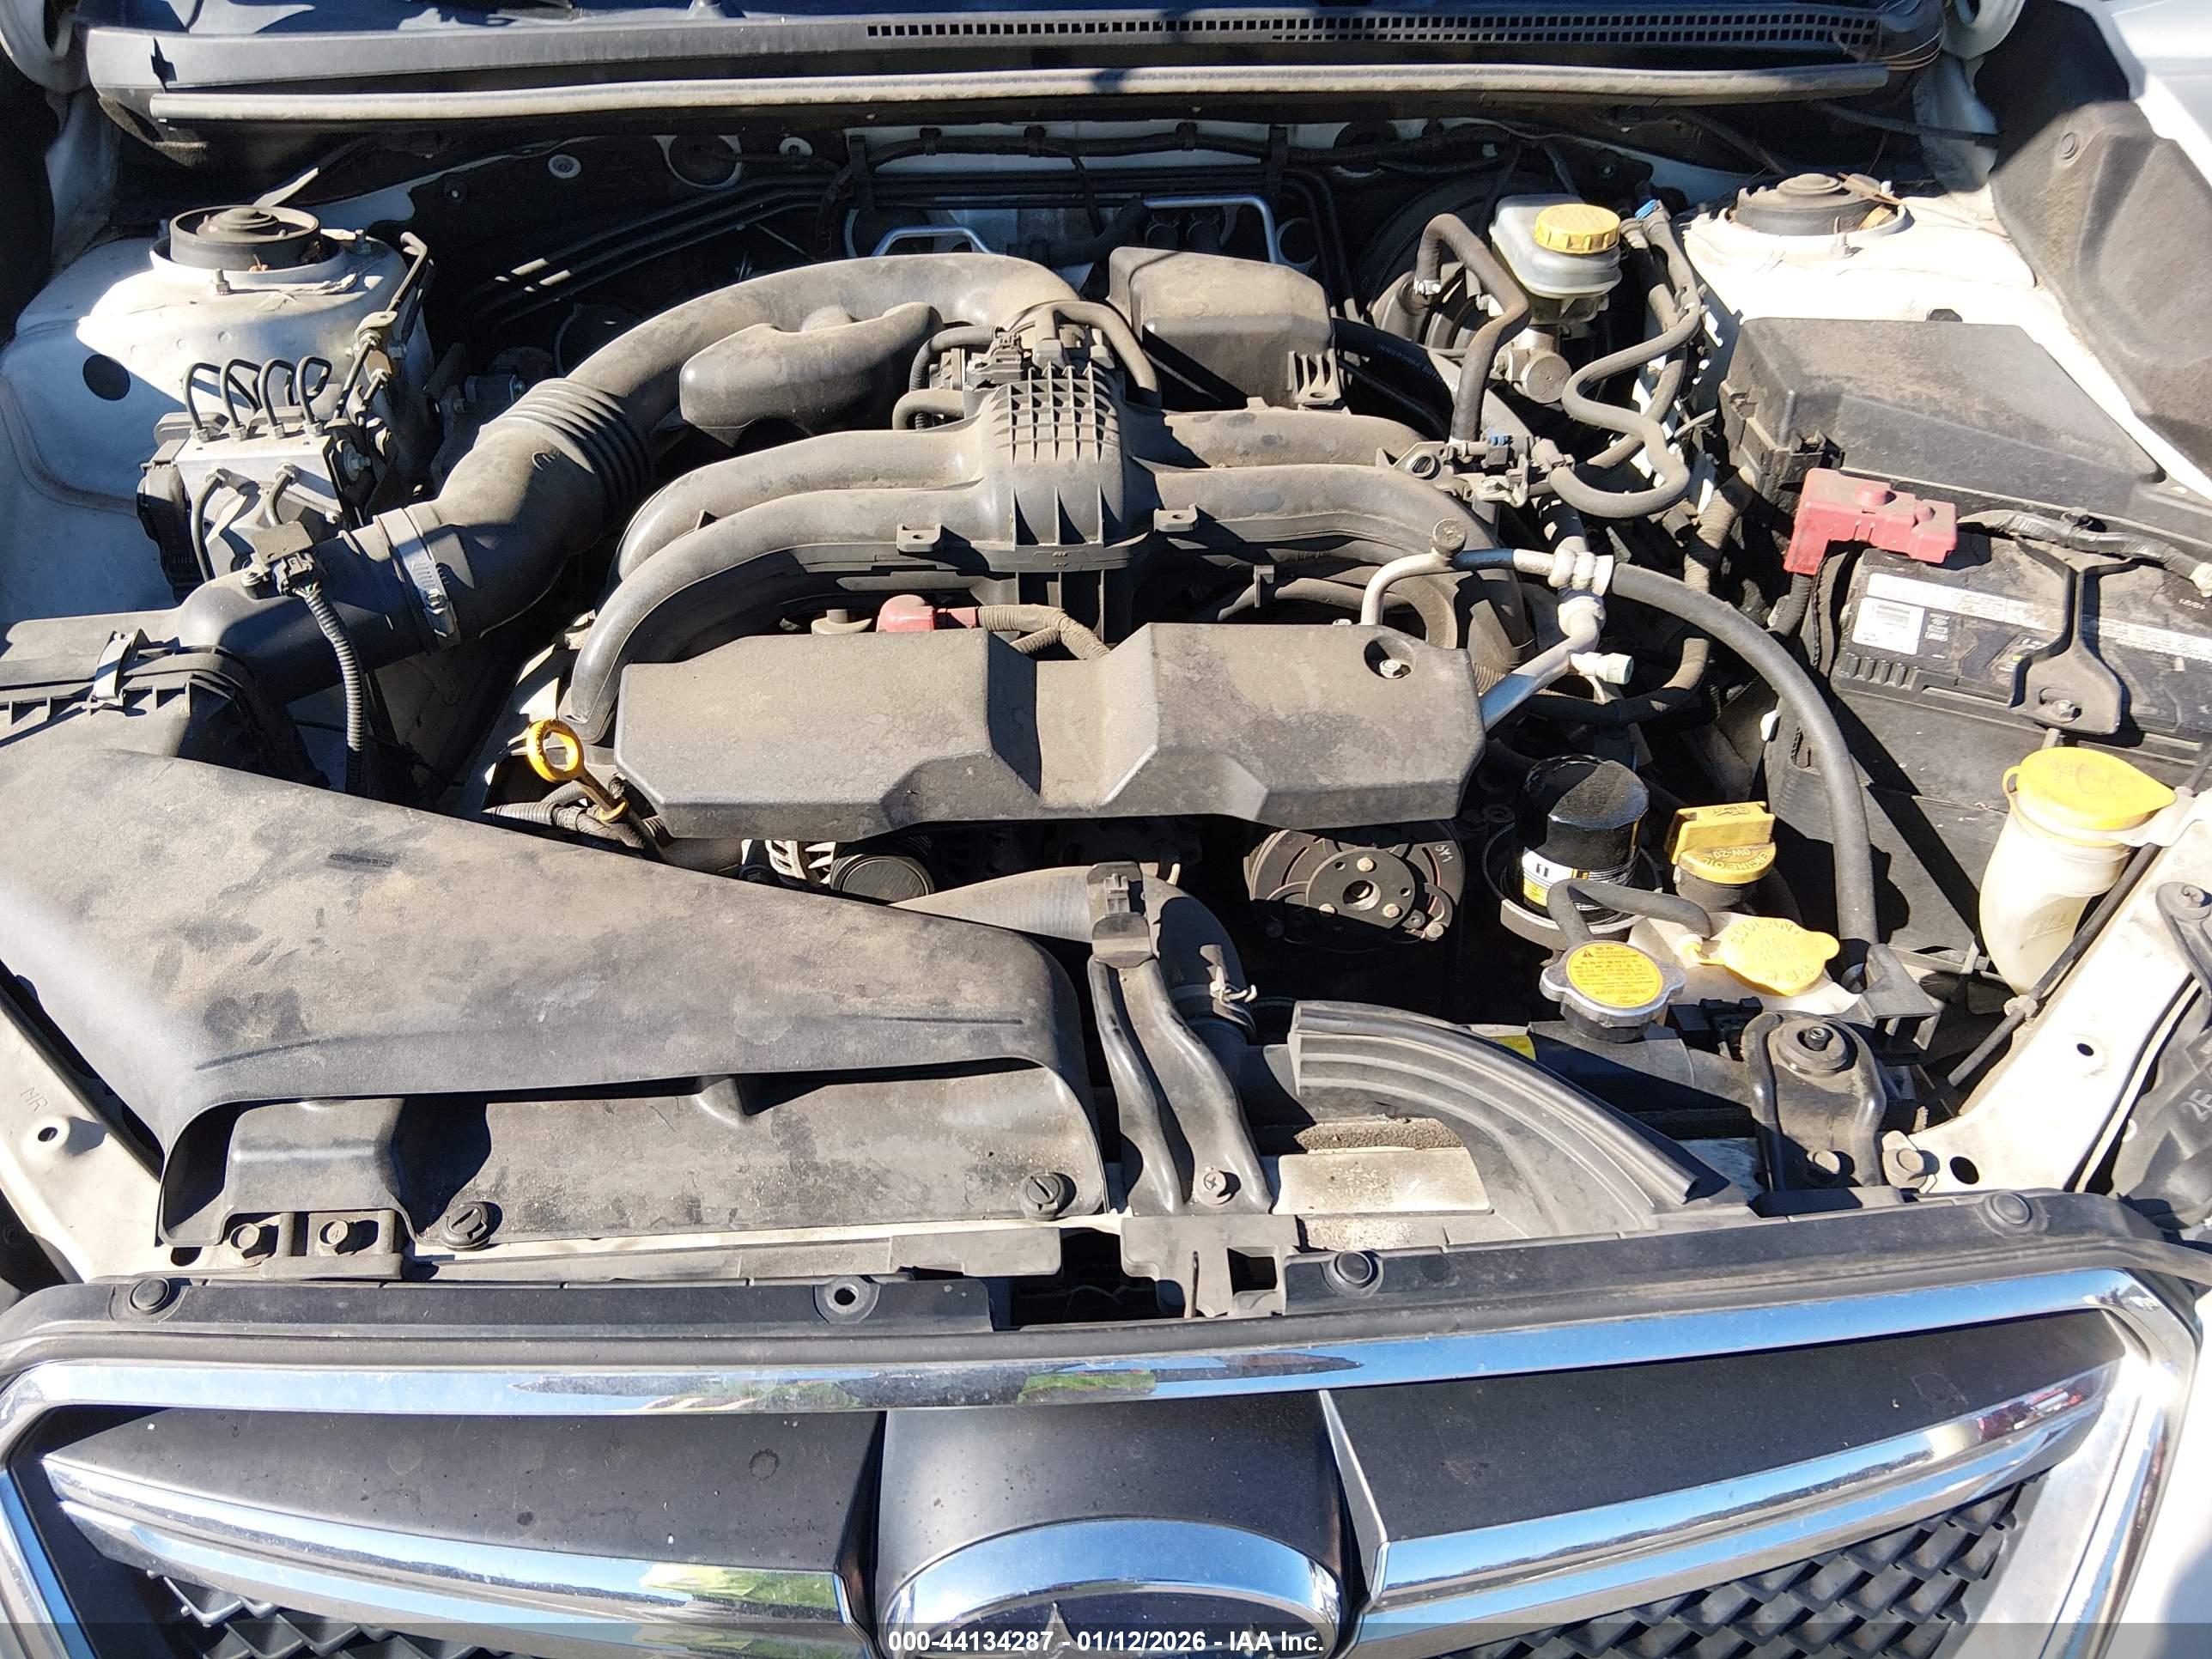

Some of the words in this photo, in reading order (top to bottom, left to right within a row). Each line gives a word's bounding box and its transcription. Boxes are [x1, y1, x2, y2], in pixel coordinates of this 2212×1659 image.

[1712, 847, 1753, 859] 0W-20
[1729, 851, 1771, 871] ENGINE
[1702, 857, 1726, 869] OIL
[20, 1086, 49, 1113] MR
